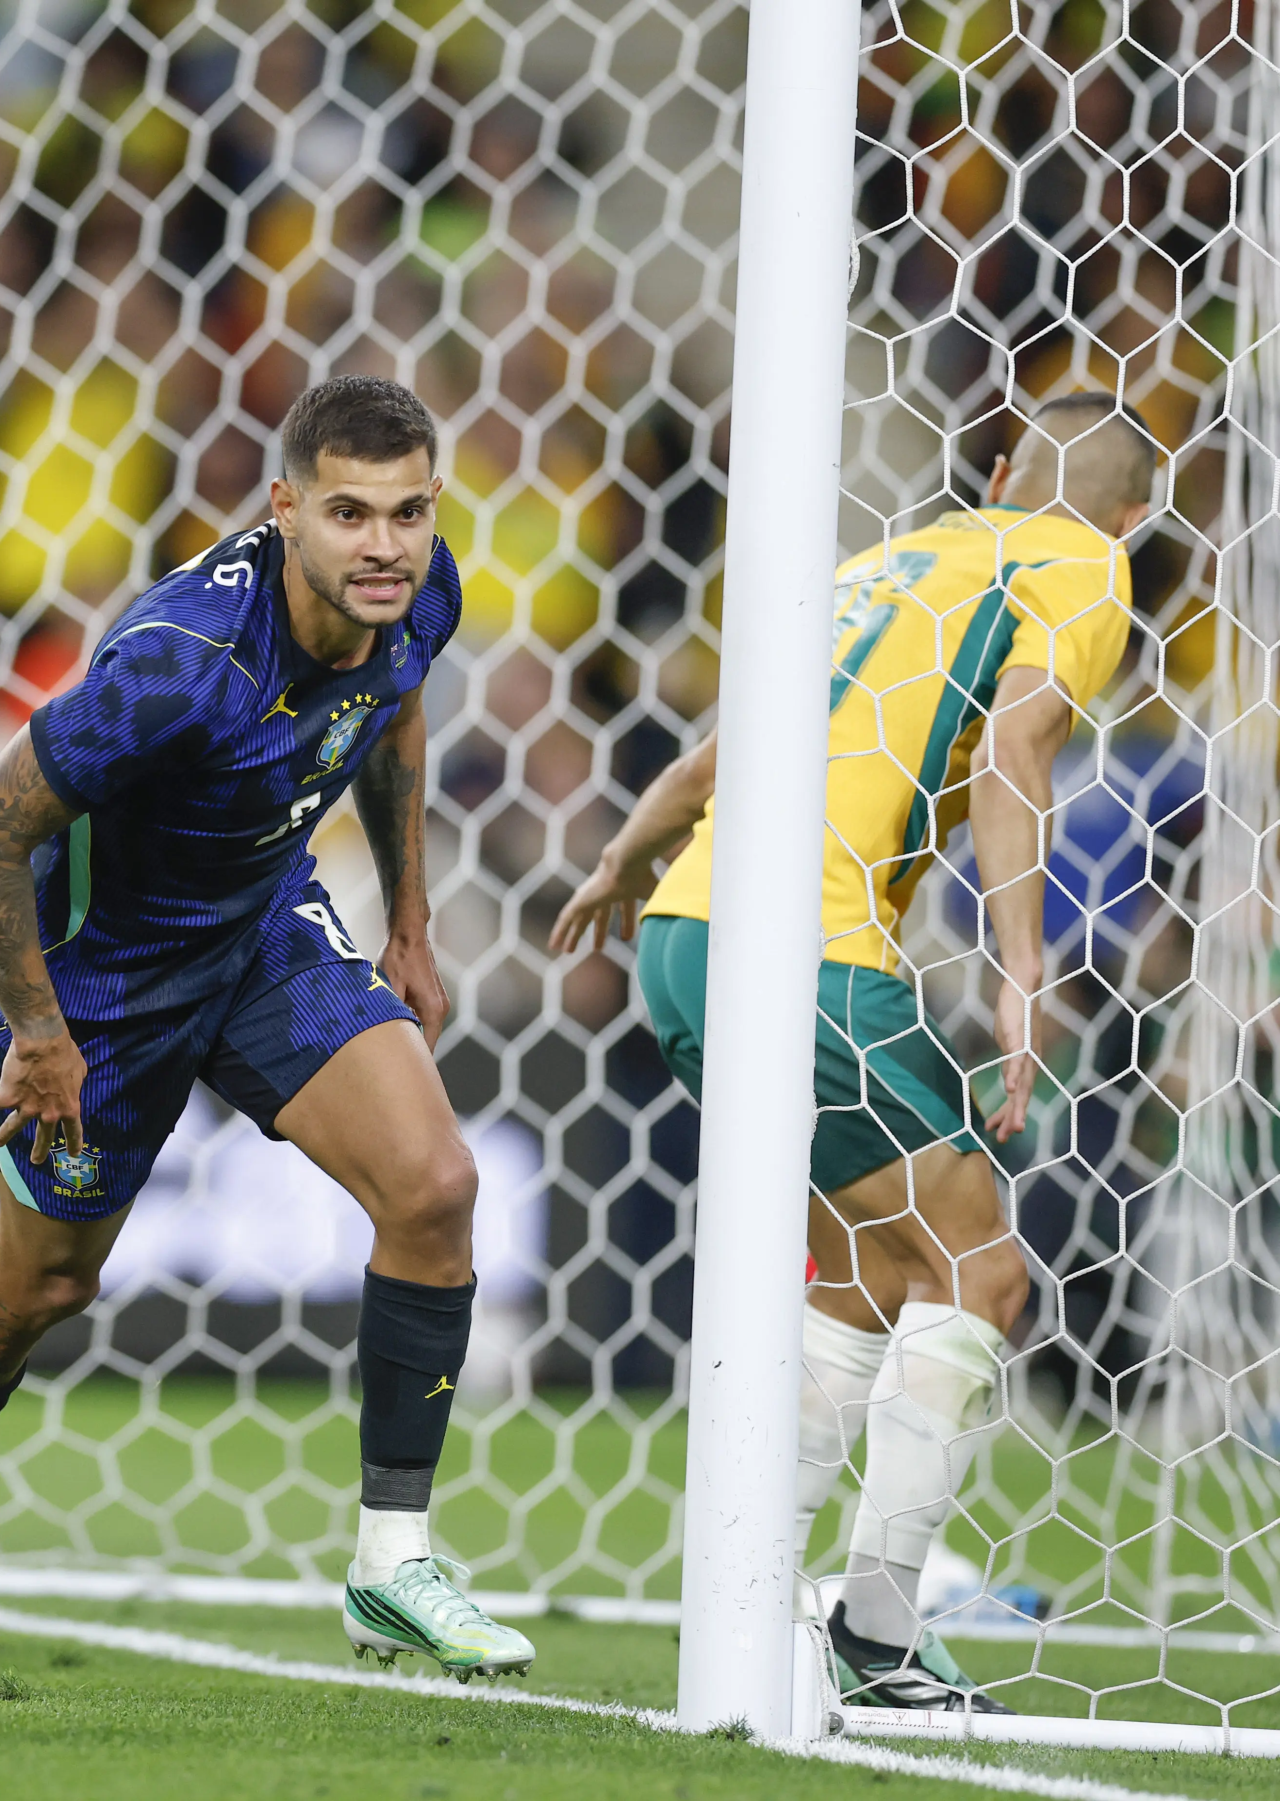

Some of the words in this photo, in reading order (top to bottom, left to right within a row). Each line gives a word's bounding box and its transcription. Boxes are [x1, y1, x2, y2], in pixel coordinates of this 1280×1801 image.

[292, 902, 366, 959] 8
[66, 1163, 84, 1171] CBF
[53, 1185, 105, 1198] BRASIL
